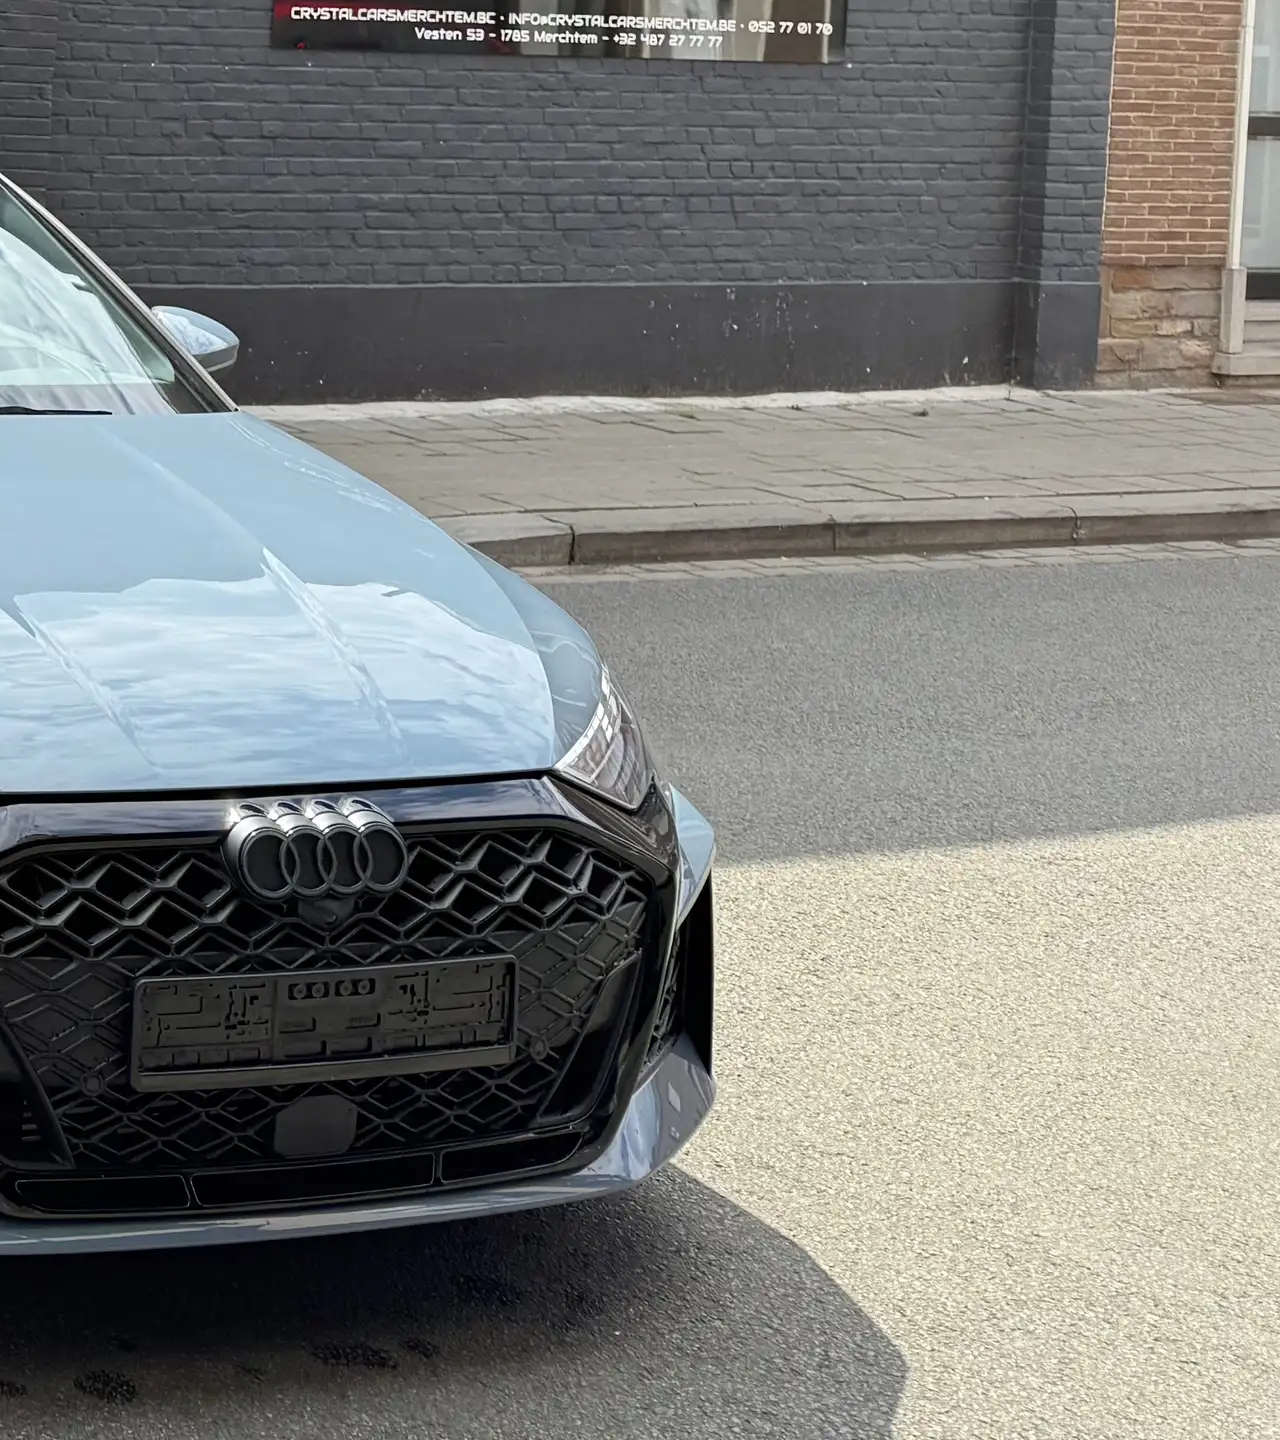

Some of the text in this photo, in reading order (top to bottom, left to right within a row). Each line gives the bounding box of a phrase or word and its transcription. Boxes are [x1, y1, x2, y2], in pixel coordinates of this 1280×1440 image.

[748, 20, 775, 33] 052
[778, 21, 793, 34] 77
[797, 22, 811, 35] 01
[815, 22, 833, 35] 70
[414, 26, 463, 41] Vesten
[466, 28, 484, 41] 53
[500, 28, 530, 42] 1785
[533, 29, 598, 44] Merchtem
[613, 33, 637, 45] +32
[640, 33, 665, 46] 487
[669, 34, 685, 46] 27
[689, 35, 704, 47] 77
[708, 35, 723, 48] 77
